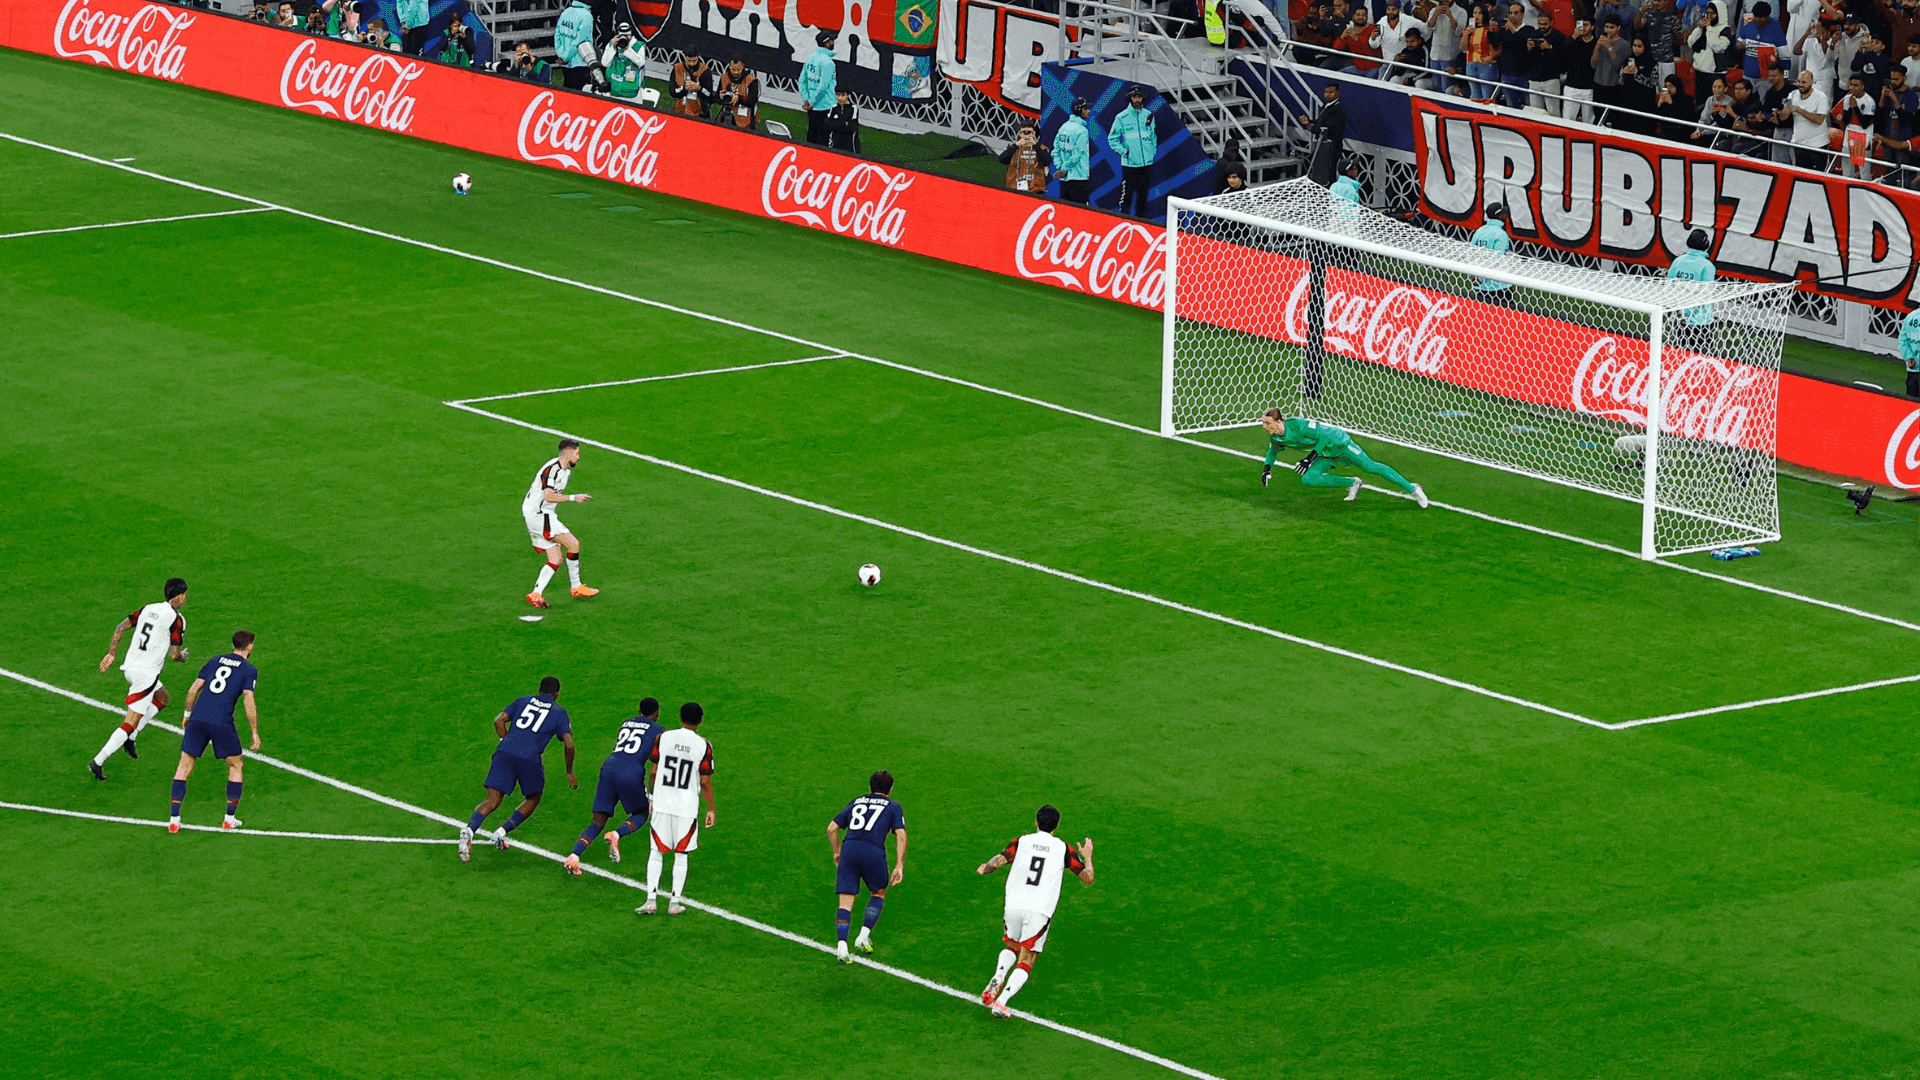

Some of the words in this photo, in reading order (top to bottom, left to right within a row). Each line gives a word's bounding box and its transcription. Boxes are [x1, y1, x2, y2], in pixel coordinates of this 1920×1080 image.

[54, 0, 196, 80] Coca-Cola
[280, 39, 425, 132] Coca-Cola
[518, 91, 667, 187] Coca-Cola
[762, 146, 915, 245] Coca-Cola
[1421, 111, 1920, 305] URUBUZAD
[1015, 204, 1166, 308] Coca-Cola
[1286, 272, 1458, 376] Cca-Cola
[139, 622, 153, 651] 5
[209, 666, 232, 694] 8
[516, 704, 549, 732] 51
[530, 697, 552, 709] PACHO
[613, 729, 646, 753] 25
[663, 756, 693, 789] 50
[849, 804, 885, 831] 87
[1033, 844, 1050, 853] PEDRO
[1026, 856, 1045, 886] 9
